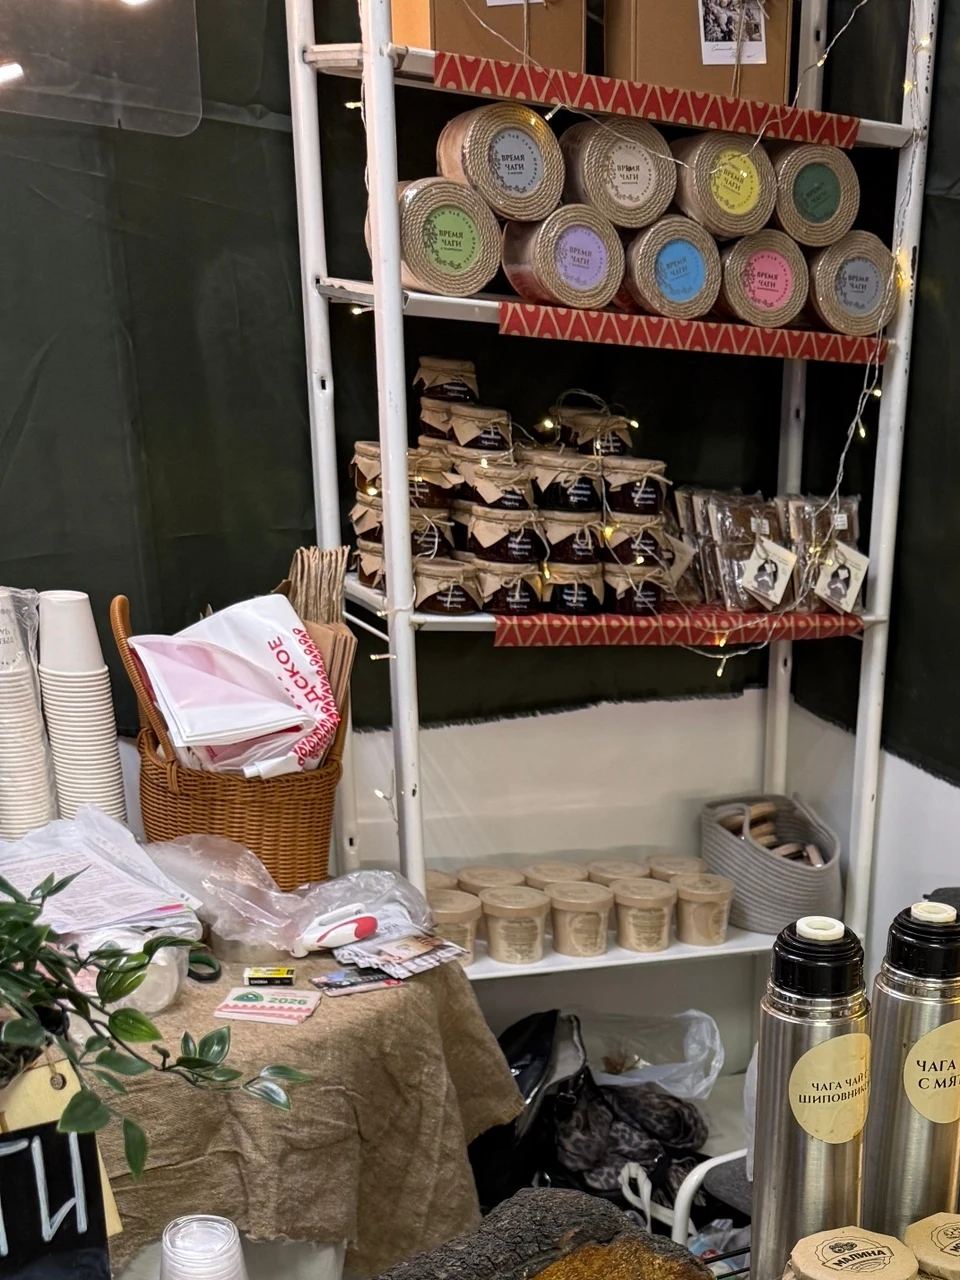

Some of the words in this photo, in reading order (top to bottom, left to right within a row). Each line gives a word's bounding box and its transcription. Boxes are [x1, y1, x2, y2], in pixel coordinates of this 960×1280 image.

[501, 154, 526, 162] ВРЕМЯ
[620, 173, 639, 181] ЧАГИ
[723, 169, 744, 184] ВРЕМЯ
[439, 230, 464, 238] ВРЕМЯ
[441, 238, 462, 247] ЧАГИ
[569, 246, 592, 257] ВРЕМЯ
[570, 255, 590, 265] ЧАГИ
[757, 271, 778, 280] ВРЕМЯ
[268, 636, 322, 711] ДСКОЕ
[916, 1058, 956, 1072] ЧАГА
[812, 1080, 843, 1092] ЧАГА
[845, 1072, 864, 1087] ЧАЙ
[831, 1248, 885, 1269] МАЛИНА
